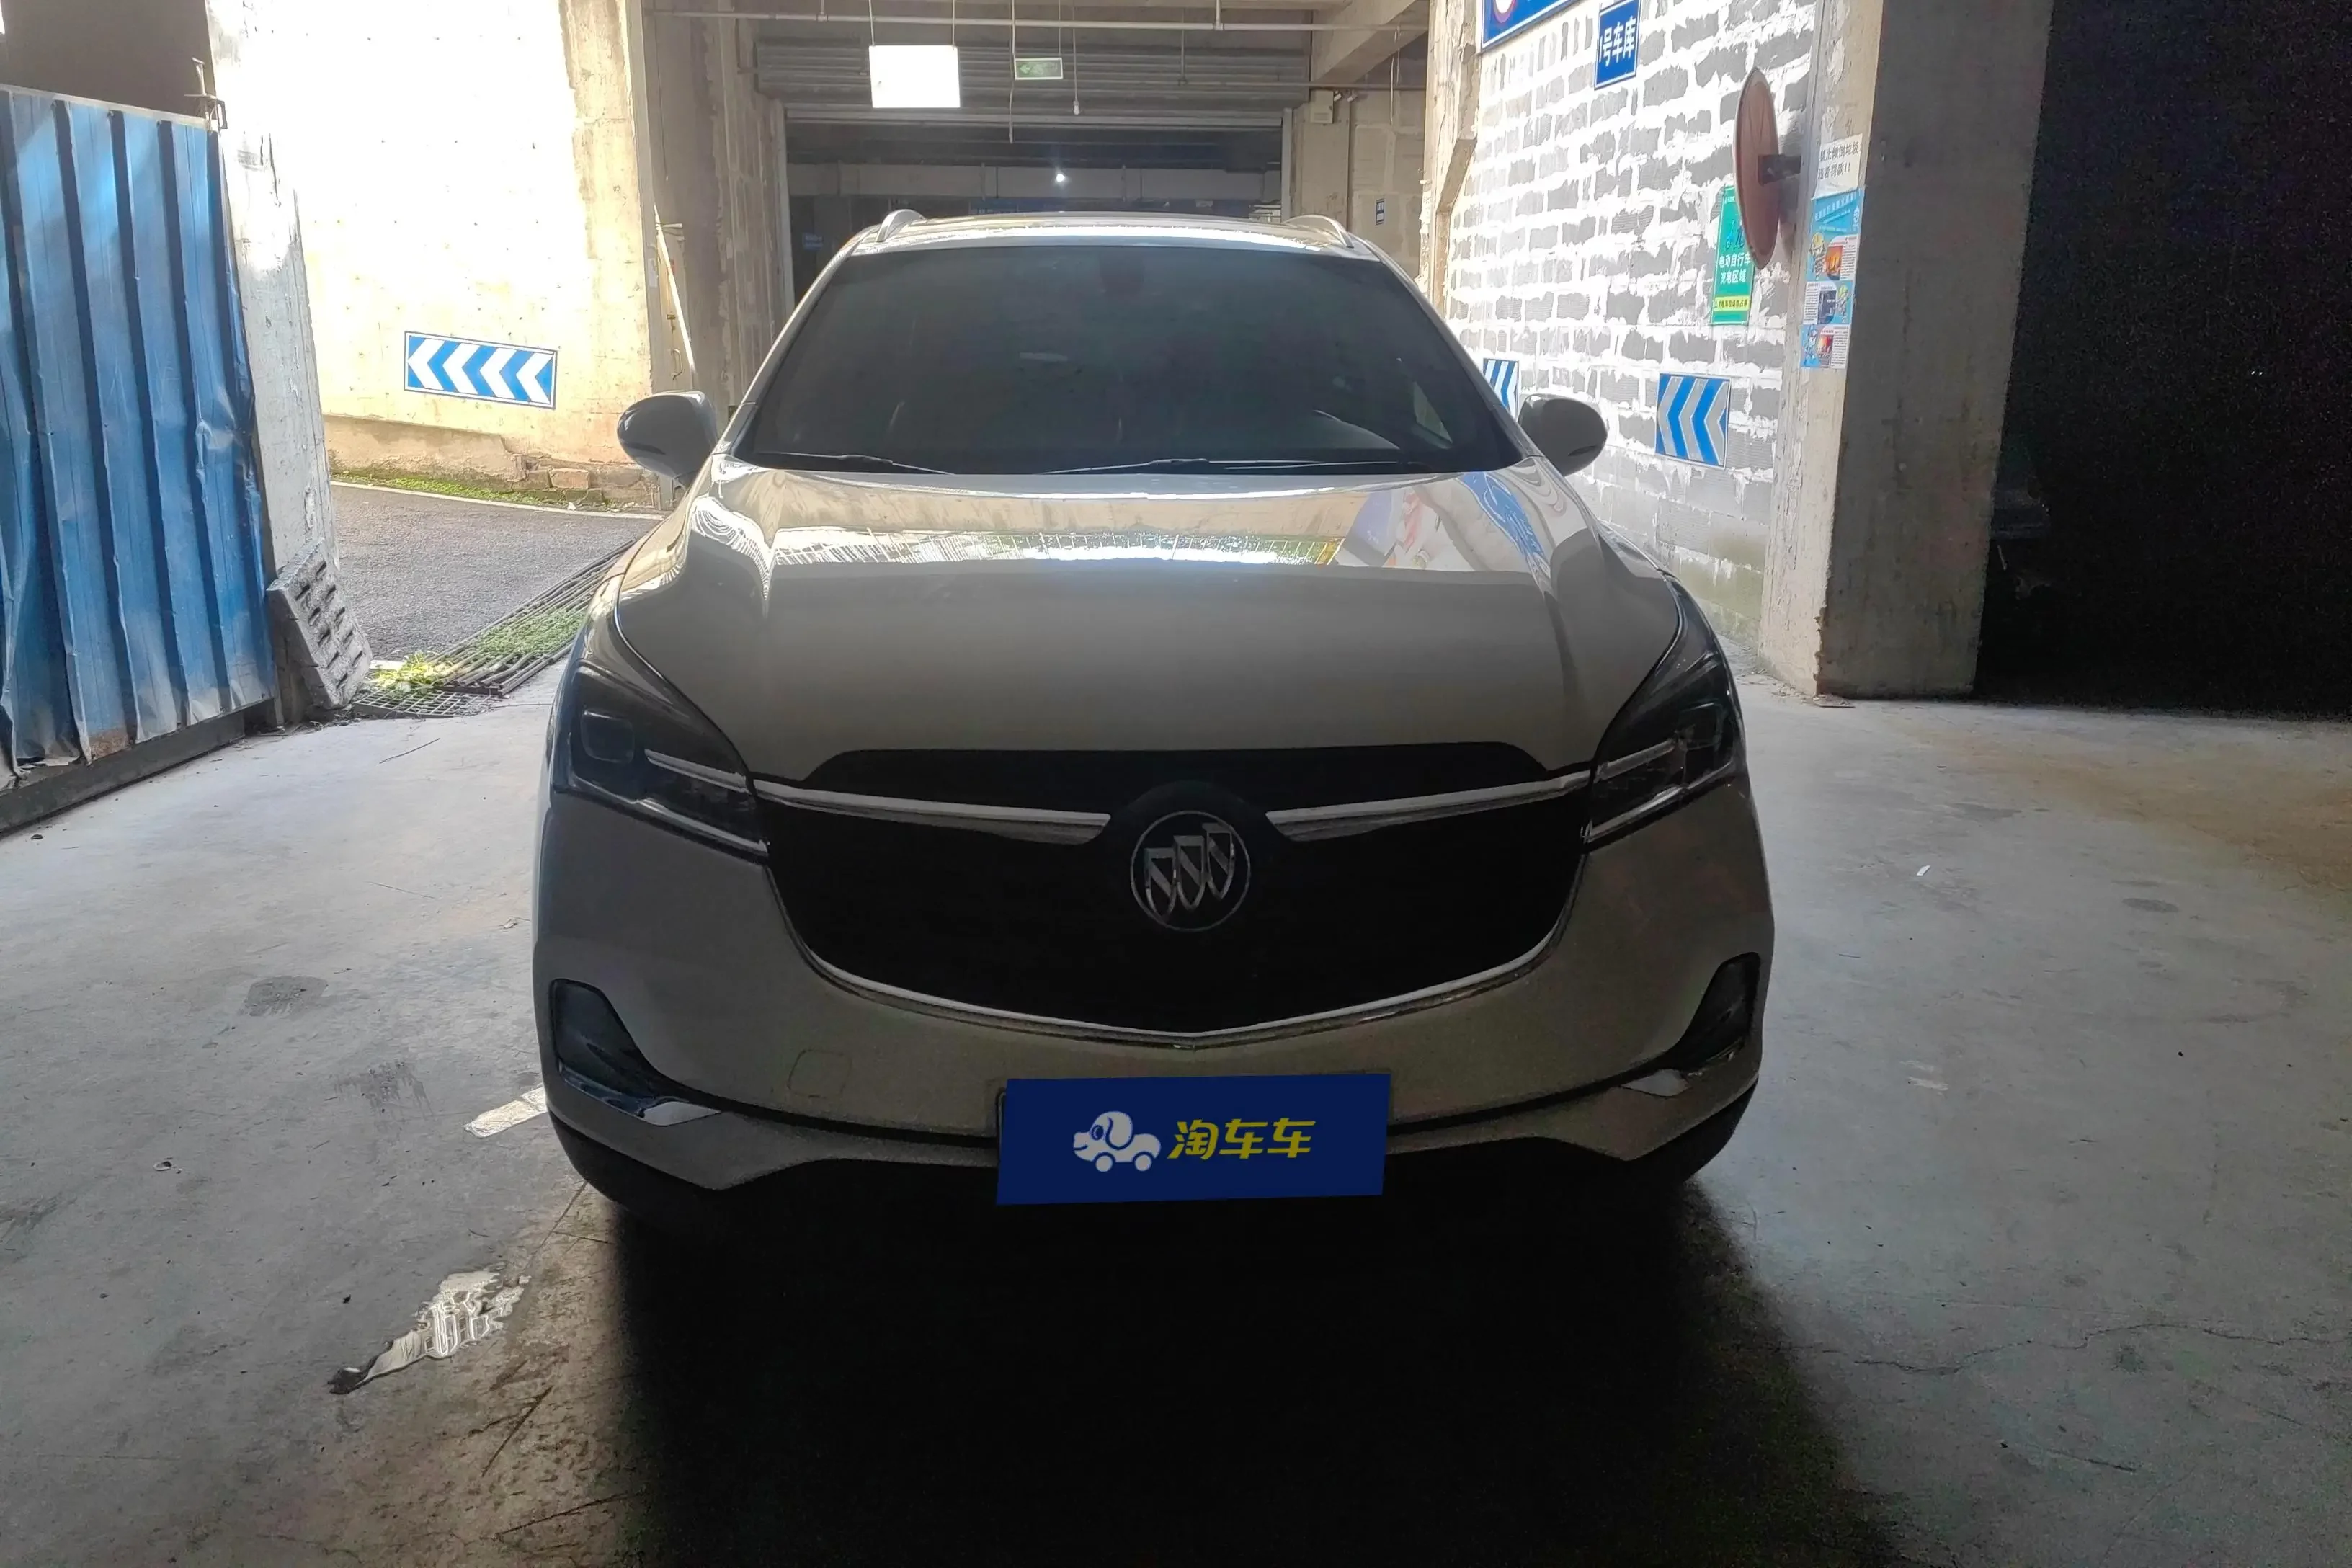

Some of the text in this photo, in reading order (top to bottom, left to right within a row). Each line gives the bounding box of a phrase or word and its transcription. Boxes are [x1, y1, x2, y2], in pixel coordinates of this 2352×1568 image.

[1598, 15, 1637, 67] 1号车库
[1719, 252, 1752, 268] 电动自行车
[1720, 269, 1747, 285] 充电区域
